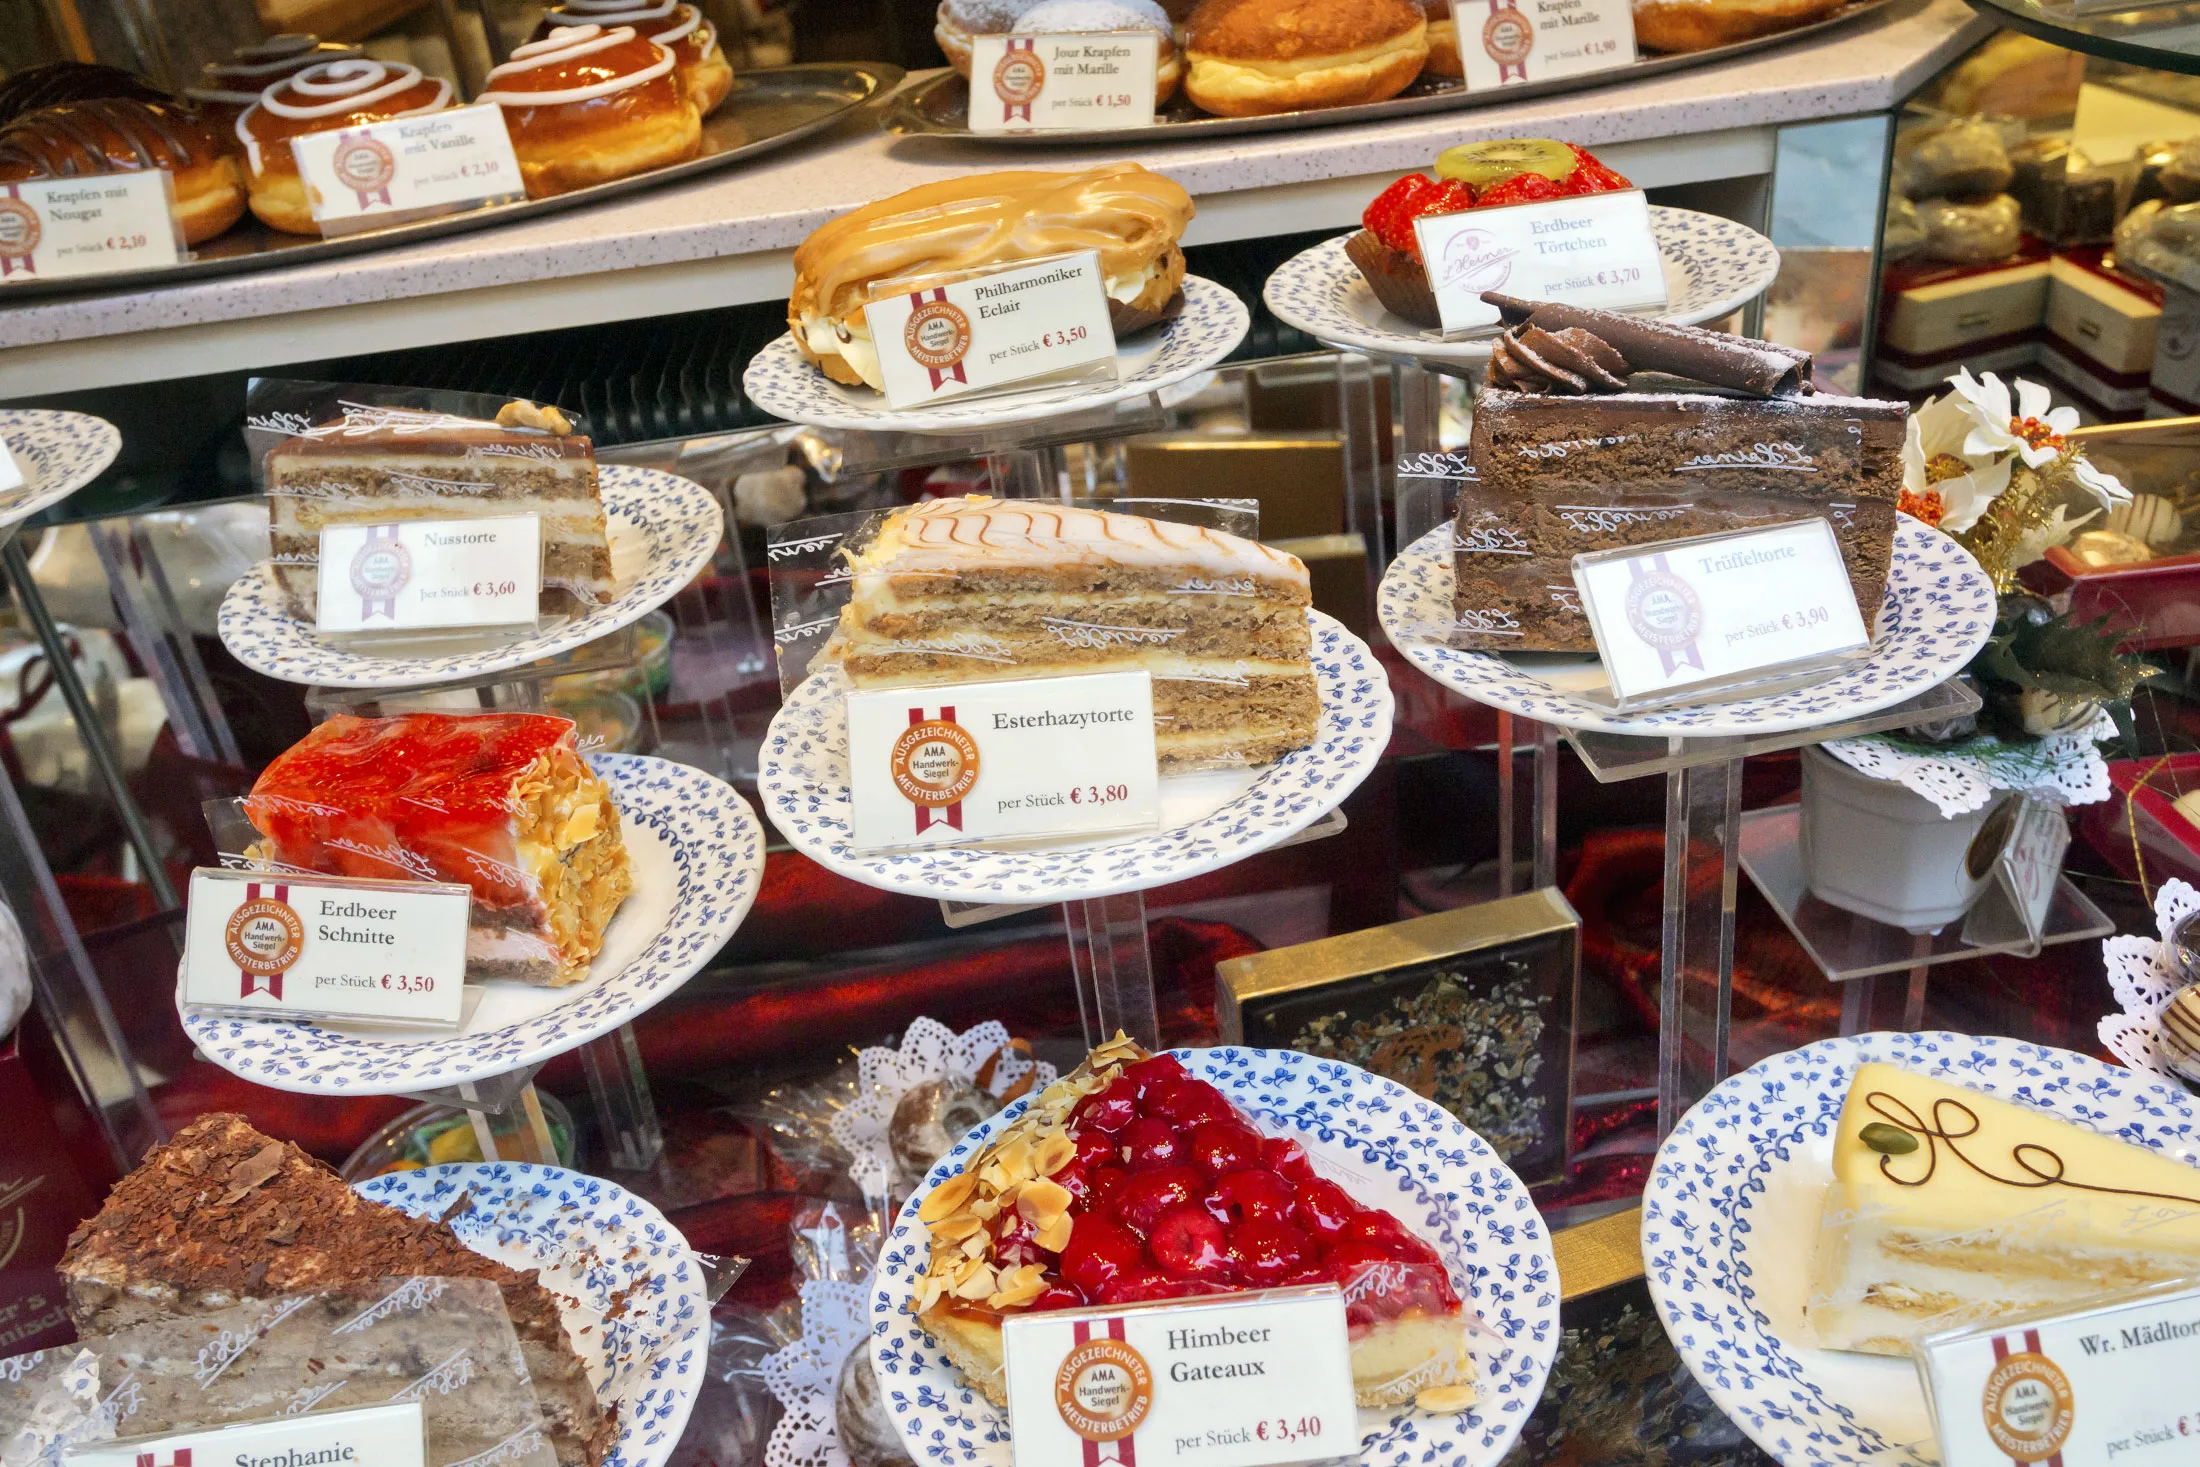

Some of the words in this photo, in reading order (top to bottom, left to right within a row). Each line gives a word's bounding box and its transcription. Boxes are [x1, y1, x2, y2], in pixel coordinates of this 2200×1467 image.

[1537, 0, 1582, 15] Krapfen
[1540, 18, 1559, 30] mit
[1562, 12, 1601, 27] Marille
[1053, 46, 1080, 61] Jour
[1083, 45, 1131, 62] Krapfen
[1544, 53, 1559, 65] per
[1560, 48, 1583, 60] Stück
[1584, 44, 1592, 55] €
[1594, 40, 1616, 56] 1,90
[1053, 63, 1074, 75] mit
[1077, 62, 1119, 75] Marille
[1052, 99, 1067, 111] per
[1068, 96, 1093, 107] Stück
[1096, 94, 1104, 106] €
[1107, 94, 1131, 109] 1,50
[399, 119, 453, 140] Krapfen
[404, 142, 427, 155] mit
[430, 135, 476, 151] Vanille
[460, 165, 470, 178] €
[474, 160, 499, 177] 2,10
[46, 187, 102, 205] Krapfen
[104, 186, 128, 200] mit
[49, 208, 102, 224] Nougat
[1530, 216, 1593, 235] Erdbeer
[106, 236, 116, 250] €
[119, 235, 147, 251] 2,10
[1534, 237, 1607, 256] Törtchen
[974, 265, 1083, 301] Philharmoniker
[1544, 281, 1562, 295] per
[1565, 273, 1595, 290] Stück
[1597, 272, 1607, 285] €
[1611, 267, 1640, 285] 3,70
[979, 300, 1021, 320] Eclair
[908, 305, 967, 341] AUSGEZEICHNETER
[927, 321, 945, 332] AMA
[910, 334, 970, 365] MEISTERBETRIEB
[929, 338, 950, 348] Siegel
[989, 349, 1008, 365] per
[1009, 339, 1041, 356] Stück
[1042, 333, 1053, 348] €
[1056, 324, 1088, 347] 3,50
[424, 532, 497, 548] Nusstorte
[1699, 545, 1796, 575] Trüffeltorte
[421, 588, 437, 602] per
[473, 582, 481, 596] €
[486, 581, 516, 598] 3,60
[1725, 630, 1745, 647] per
[1747, 620, 1780, 639] Stück
[1782, 614, 1794, 630] €
[1796, 606, 1829, 629] 3,90
[992, 707, 1135, 732] Esterhazytorte
[894, 726, 976, 766] AUSGEZEICHNETER
[923, 746, 946, 758] AMA
[912, 758, 960, 771] Handwerk-
[923, 768, 950, 780] Siegel
[896, 768, 976, 802] MEISTERBETRIEB
[997, 799, 1021, 814] per
[1025, 791, 1066, 808] Stück
[1069, 786, 1082, 804] €
[1087, 784, 1128, 807] 3,80
[319, 899, 398, 921] Erdbeer
[229, 903, 301, 939] AUSGEZEICHNETER
[255, 921, 275, 932] AMA
[243, 932, 286, 943] Handwerk-
[318, 925, 395, 945] Schnitte
[229, 941, 299, 971] MEISTERBETRIEB
[252, 941, 276, 951] Siegel
[315, 975, 337, 989] per
[340, 973, 376, 989] Stück
[381, 974, 391, 990] €
[397, 975, 434, 994] 3,50
[1167, 1326, 1272, 1350] Himbeer
[2079, 1334, 2116, 1356] Wr.
[1058, 1346, 1148, 1391] AUSGEZEICHNETER
[1091, 1368, 1116, 1382] AMA
[1170, 1359, 1266, 1383] Gateaux
[1079, 1384, 1132, 1397] Handwerk-
[2015, 1384, 2038, 1399] AMA
[1091, 1395, 1120, 1407] Siegel
[1061, 1395, 1149, 1434] MEISTERBETRIEB
[1175, 1437, 1202, 1454] per
[1206, 1426, 1250, 1446] Stück
[1256, 1420, 1270, 1441] €
[1276, 1415, 1322, 1443] 3,40
[2106, 1437, 2131, 1459] per
[2134, 1424, 2175, 1447] Stück
[2177, 1415, 2190, 1436] €
[235, 1441, 355, 1467] Stephanie
